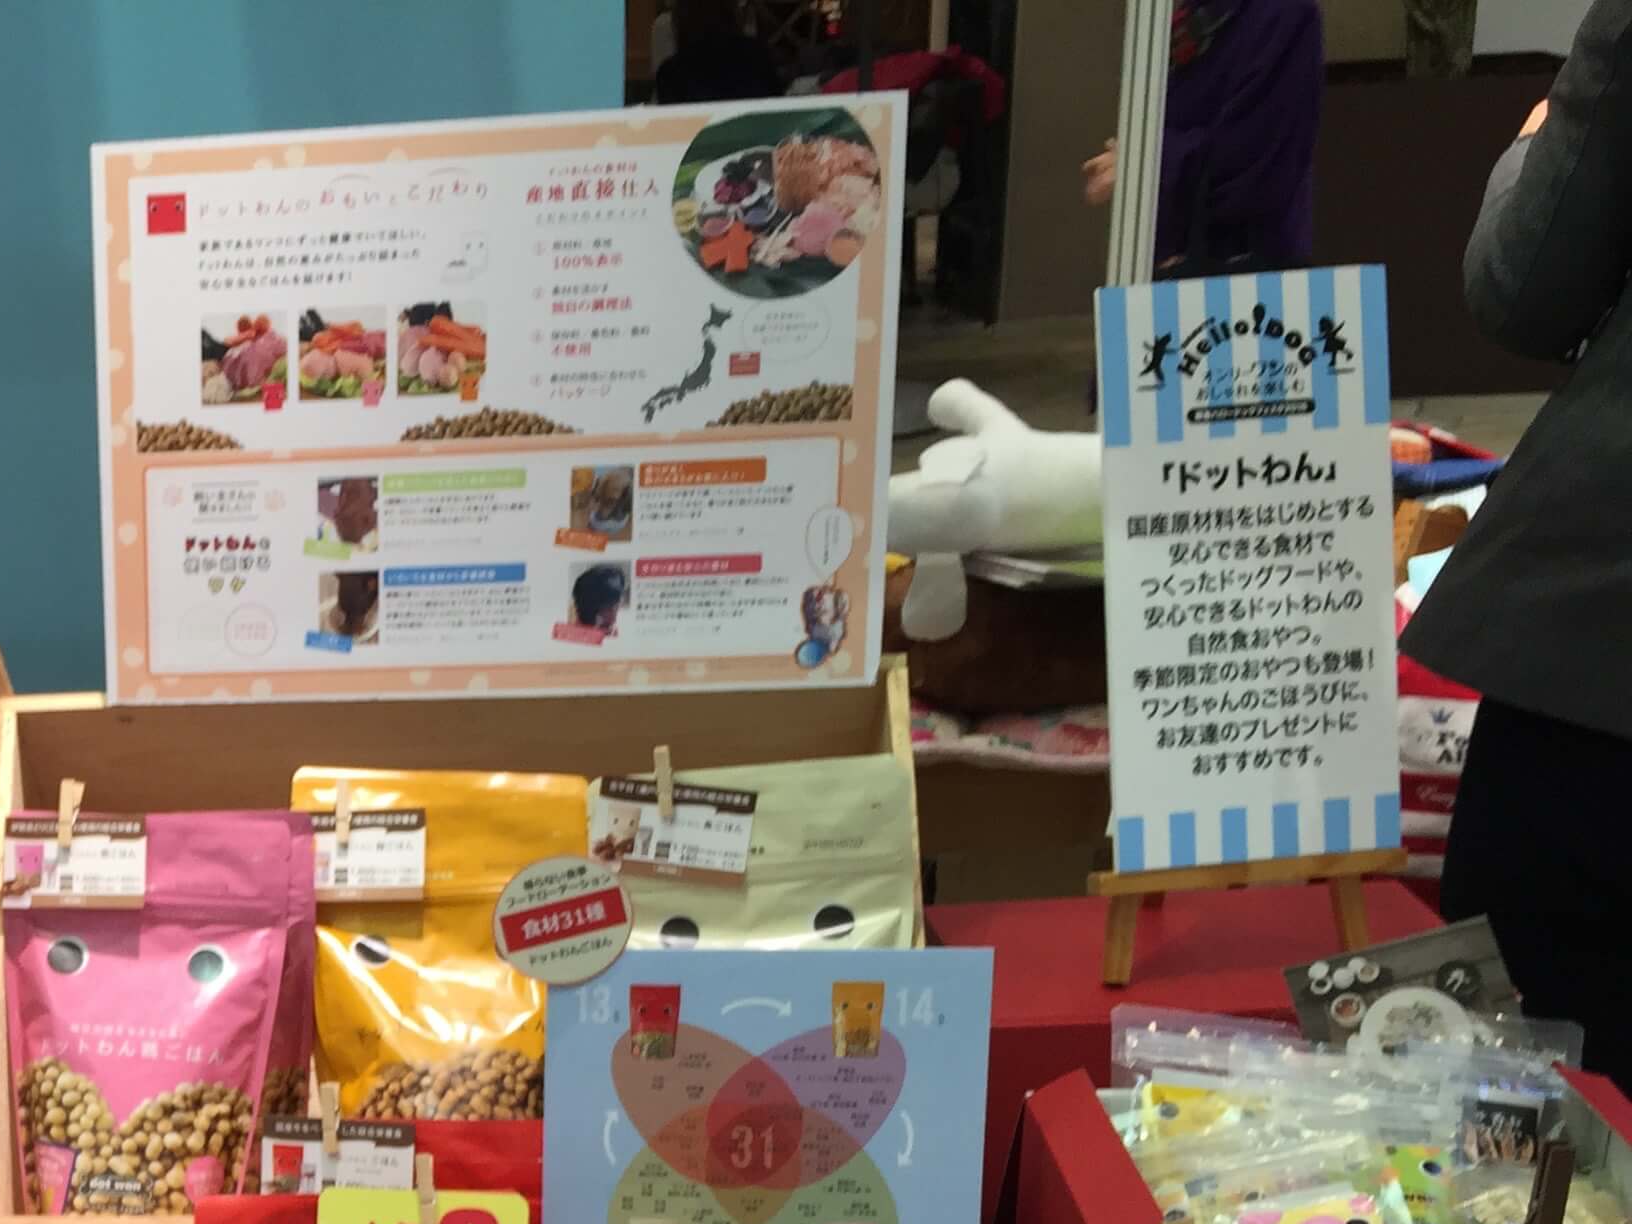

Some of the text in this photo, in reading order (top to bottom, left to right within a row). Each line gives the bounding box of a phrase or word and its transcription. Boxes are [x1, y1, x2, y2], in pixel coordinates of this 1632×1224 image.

[1162, 451, 1337, 494] 「ドットわん」
[1127, 495, 1375, 539] 国産原材料をはじめとする
[1169, 530, 1334, 567] 安心できる食材で
[1140, 559, 1363, 598] つくったドッグフードや、
[1144, 590, 1363, 630] 安心できるドットわんの
[1188, 625, 1323, 657] 自然食おやつ。
[1133, 648, 1375, 690] 季節限定のおやつも登場！
[1141, 680, 1368, 720] ワンちゃんのごほうびに、
[1157, 711, 1358, 749] お友達のプレゼントに
[1192, 745, 1323, 776] おすすめです。
[521, 900, 607, 940] 食材31種
[575, 984, 611, 1025] 13
[896, 986, 934, 1027] 14
[730, 1124, 774, 1170] 31
[89, 1176, 142, 1192] dot wan
